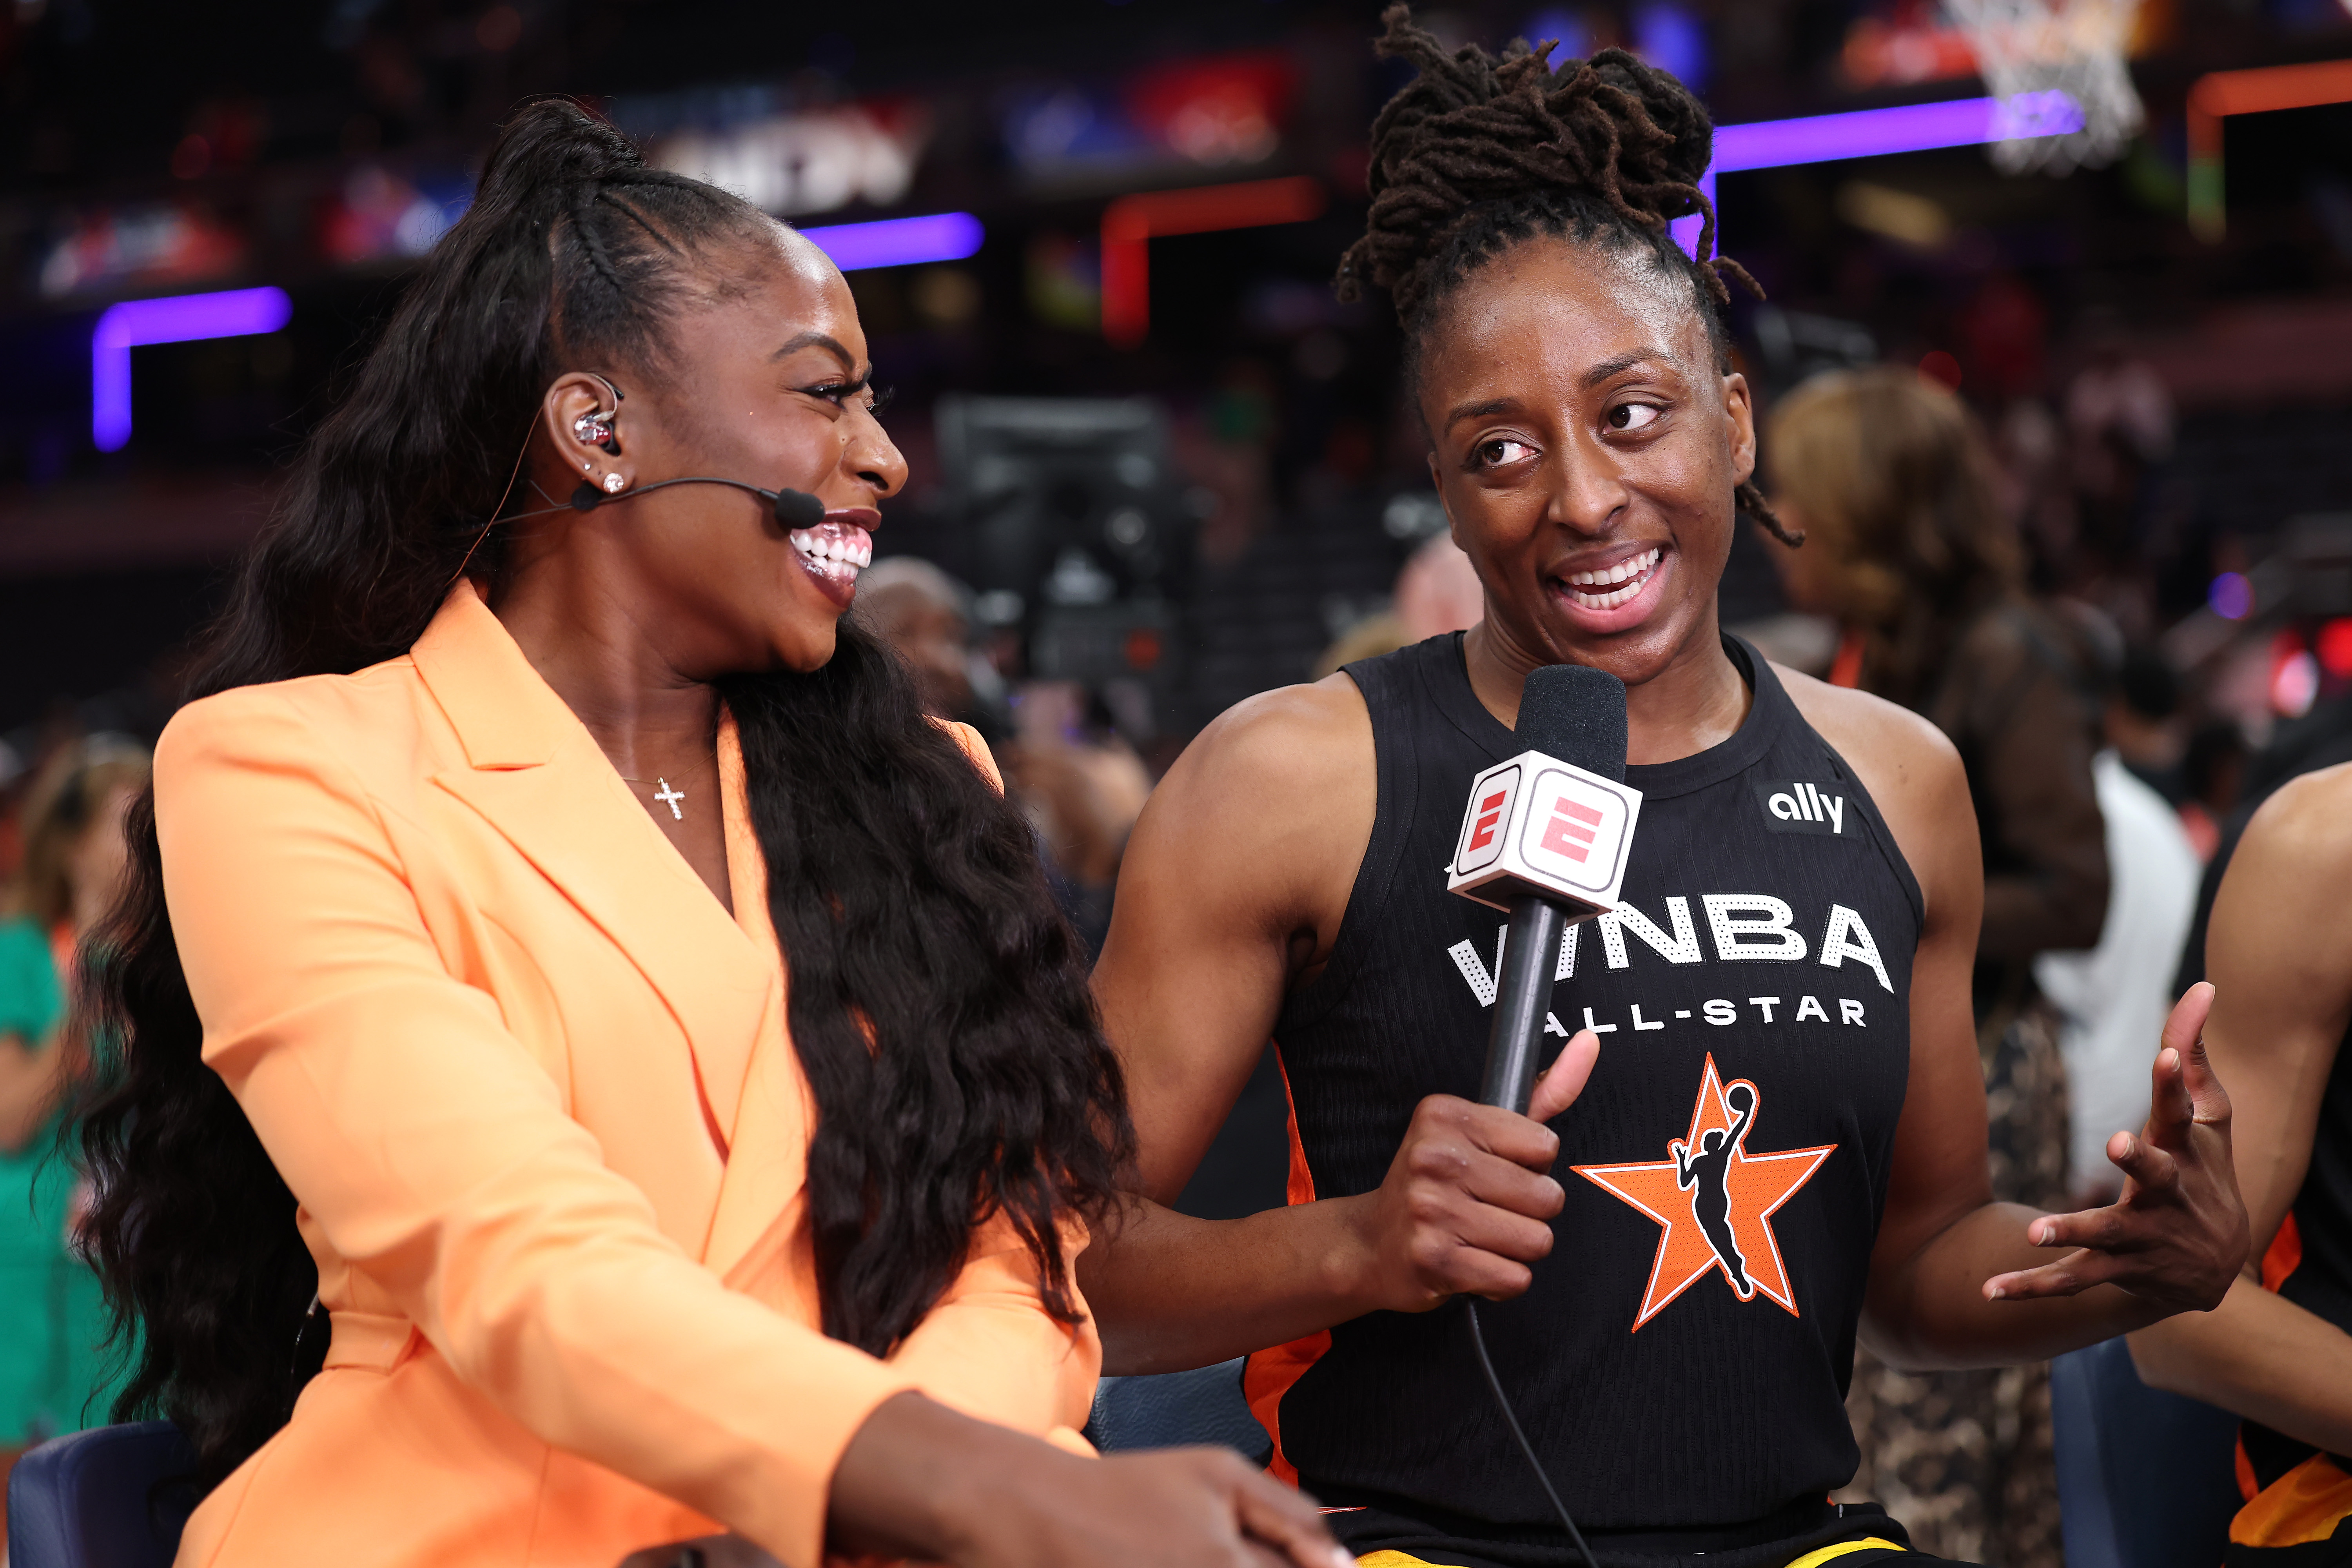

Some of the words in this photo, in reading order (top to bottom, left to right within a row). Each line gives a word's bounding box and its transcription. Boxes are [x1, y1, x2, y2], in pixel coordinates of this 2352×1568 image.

[1468, 789, 1507, 853] E
[1540, 796, 1604, 864] E
[1768, 783, 1843, 834] ally
[1543, 996, 1866, 1037] ALL-STAR
